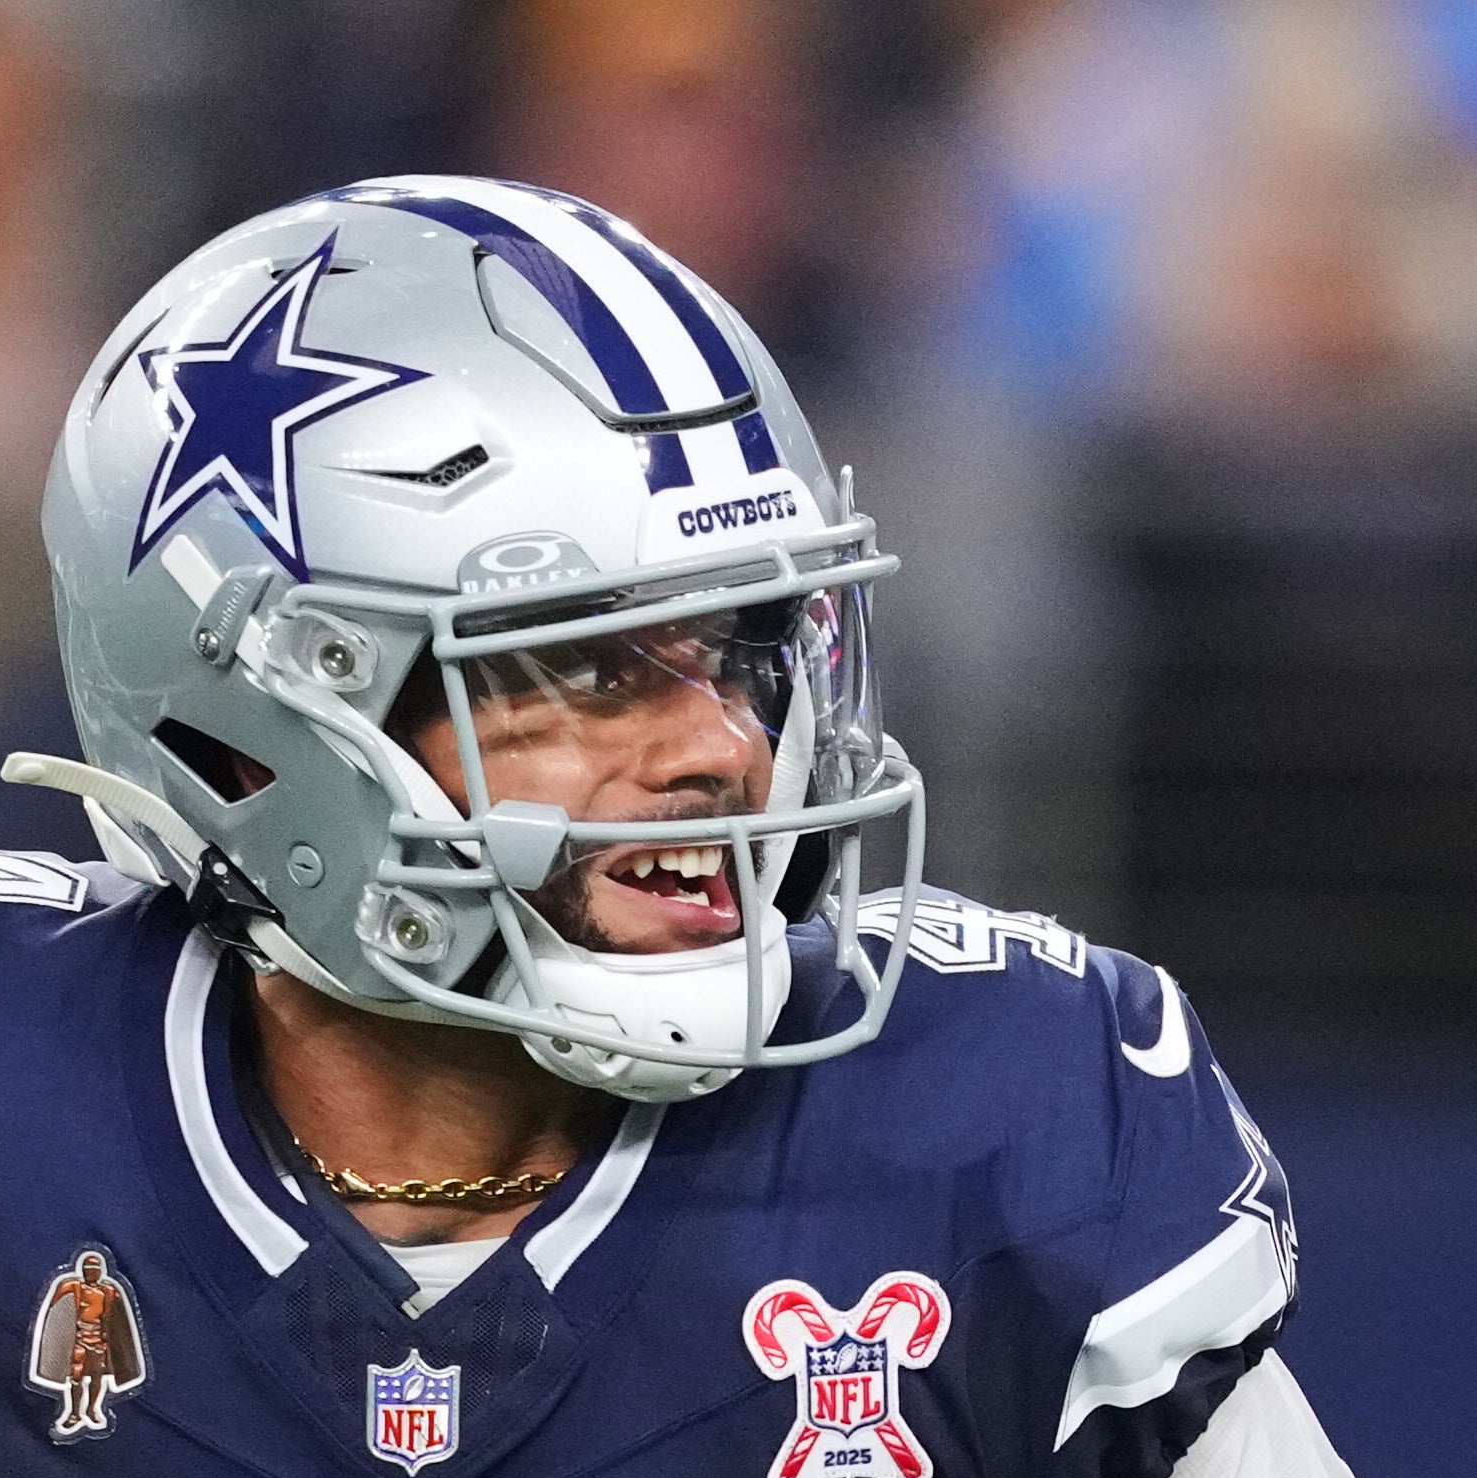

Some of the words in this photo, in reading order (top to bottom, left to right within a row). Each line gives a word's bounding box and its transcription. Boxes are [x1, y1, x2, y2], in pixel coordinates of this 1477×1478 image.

[678, 490, 797, 537] COWBOYS
[825, 894, 1086, 978] 4
[814, 1377, 880, 1425] NFL
[382, 1409, 444, 1452] NFL
[824, 1448, 872, 1467] 2025
